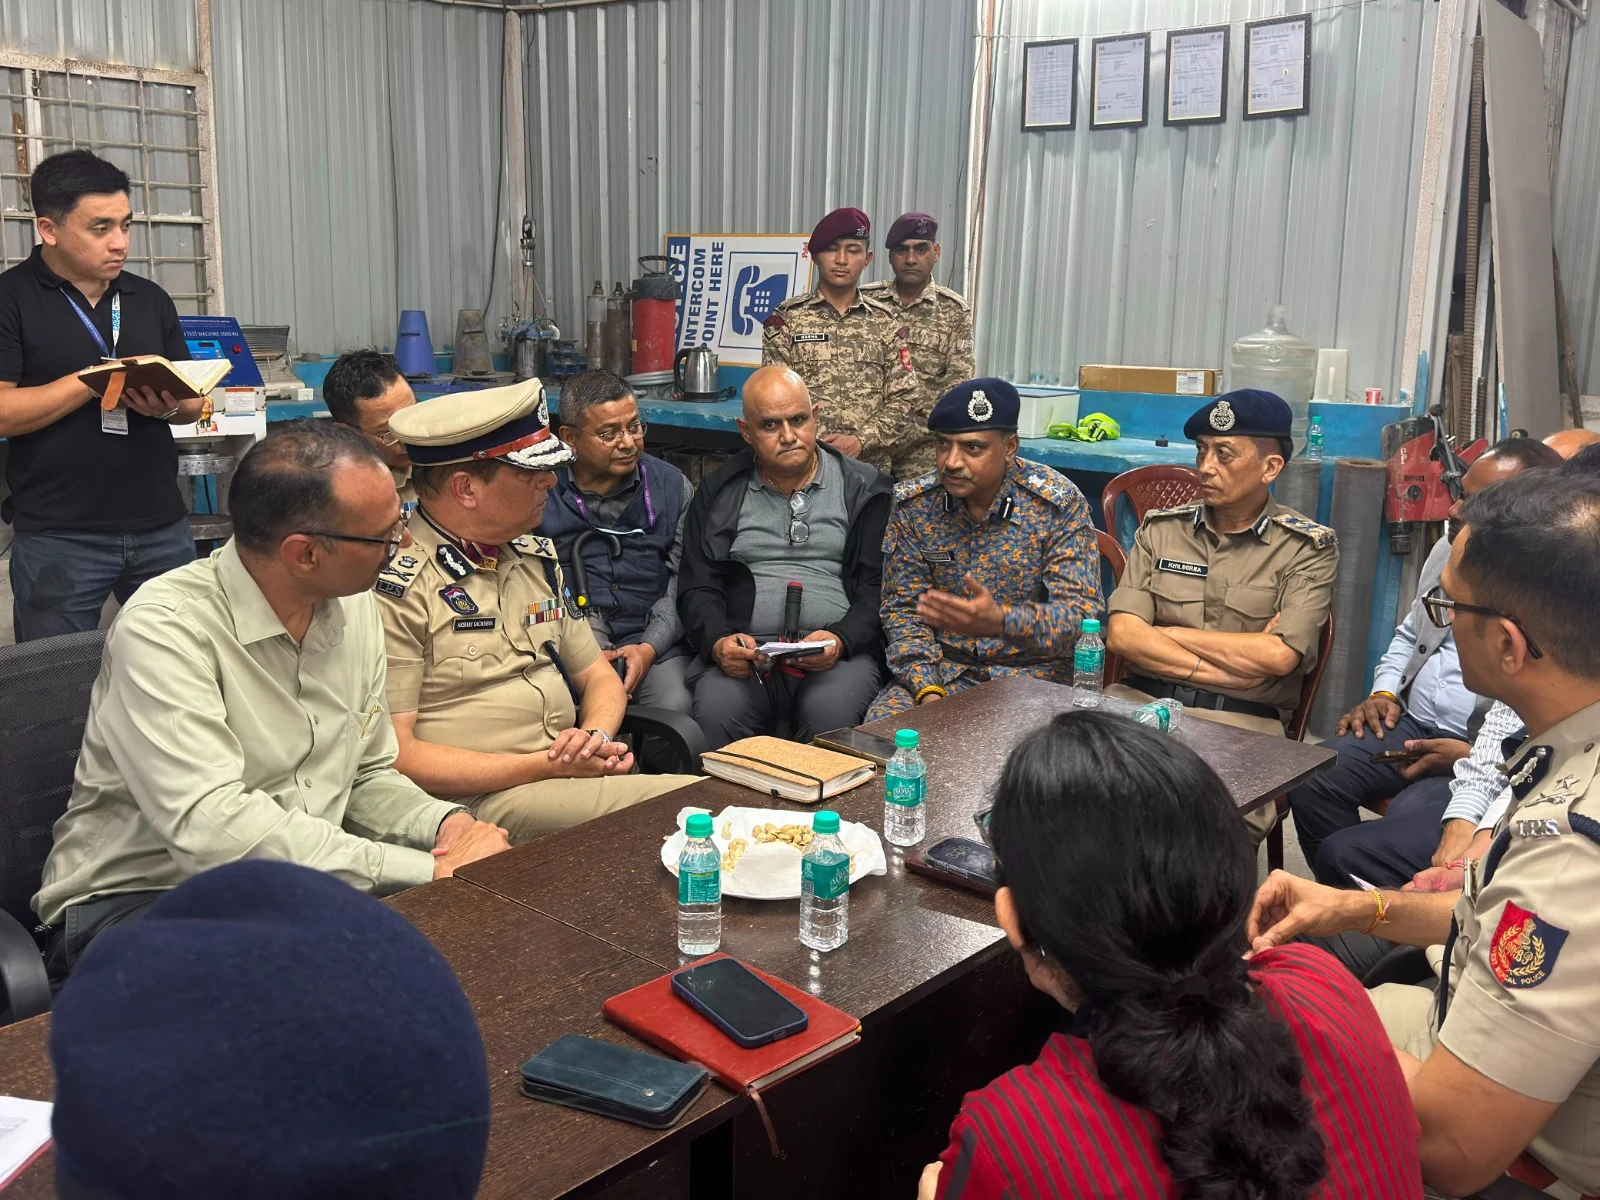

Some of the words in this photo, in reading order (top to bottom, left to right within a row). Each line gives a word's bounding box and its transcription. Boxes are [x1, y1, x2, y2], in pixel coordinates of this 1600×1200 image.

[709, 242, 724, 292] HERE
[683, 248, 706, 347] INTERCOM
[1516, 819, 1561, 837] IPS
[1520, 970, 1546, 985] POLICE
